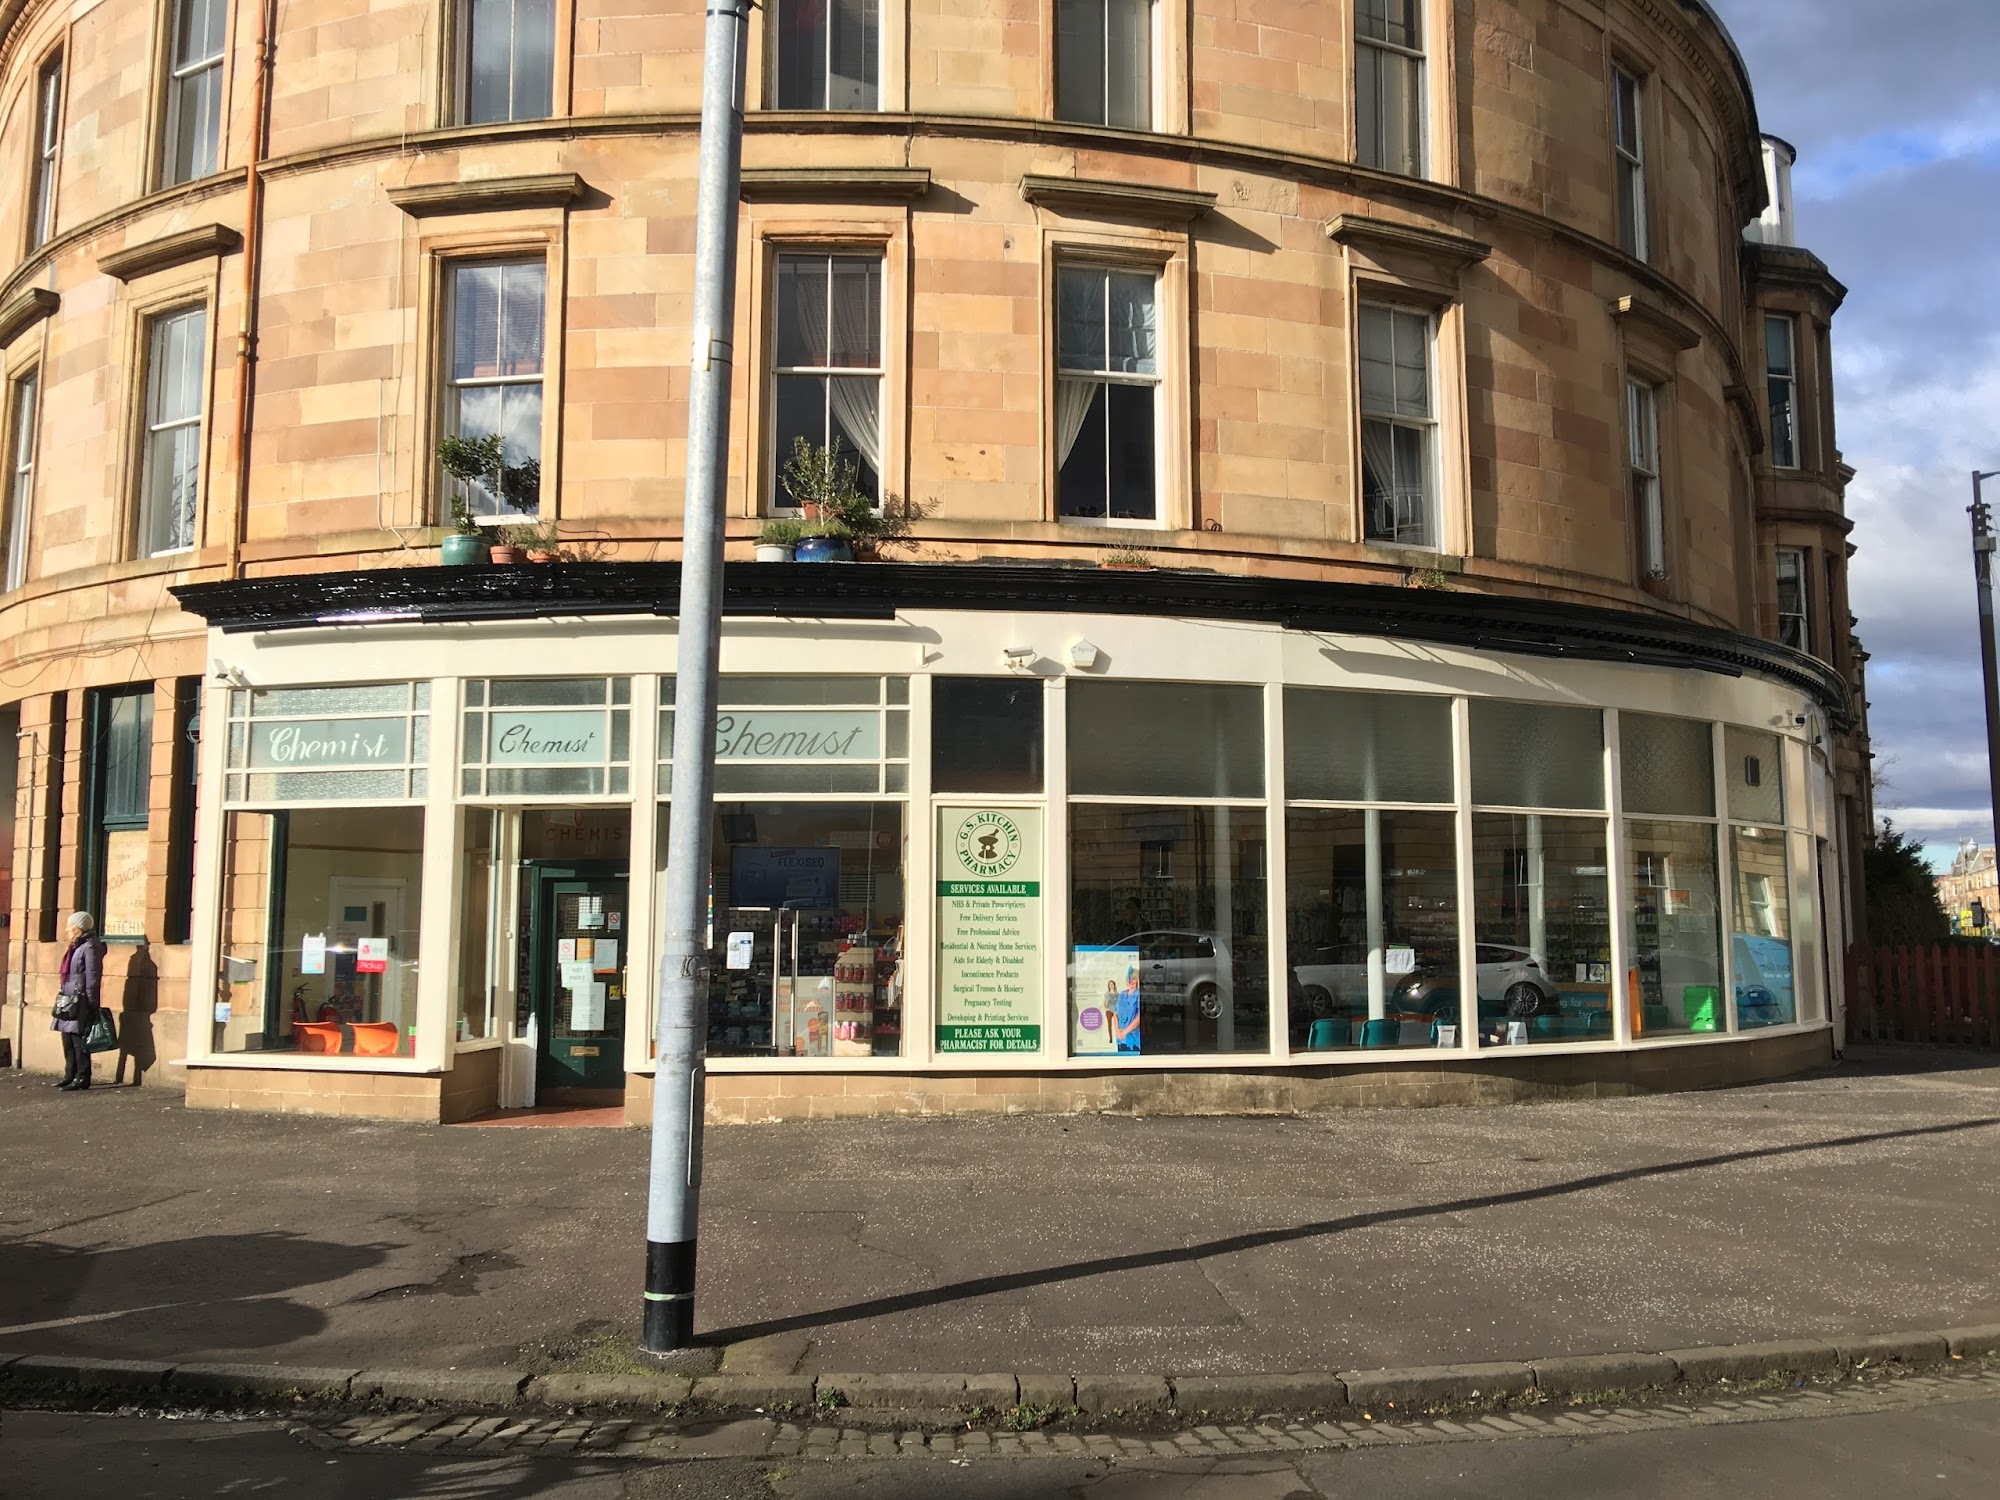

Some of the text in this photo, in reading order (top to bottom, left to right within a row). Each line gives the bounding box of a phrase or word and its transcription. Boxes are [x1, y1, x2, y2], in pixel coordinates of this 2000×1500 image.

[499, 724, 596, 753] Chemist
[269, 727, 389, 761] Chemist
[977, 813, 1019, 842] KITCHIN
[545, 827, 629, 841] CHEMIS
[778, 857, 825, 869] FLEXISEQ
[960, 849, 1016, 875] PHARMACY
[950, 884, 1027, 894] SERVICES AVAILABLE
[952, 900, 1025, 909] NHS & Private Prescriptions
[959, 913, 971, 921] Free
[972, 914, 994, 922] Delivery
[957, 928, 1020, 936] Free Professional Advice
[940, 942, 1037, 951] Residential & Nursing Home Services
[360, 961, 384, 970] Pickup
[953, 956, 1024, 965] Aids for Elderly & Disabled
[961, 970, 1019, 978] Incontinence Products
[953, 984, 1024, 994] Surgical Trusses & Hosiery
[964, 998, 1012, 1007] Pregnancy Testing
[947, 1013, 1029, 1022] Developing & Printing Services
[954, 1028, 1022, 1038] PLEASE ASK YOUR
[940, 1039, 1037, 1050] PHARMACIST FOR DETAILS
